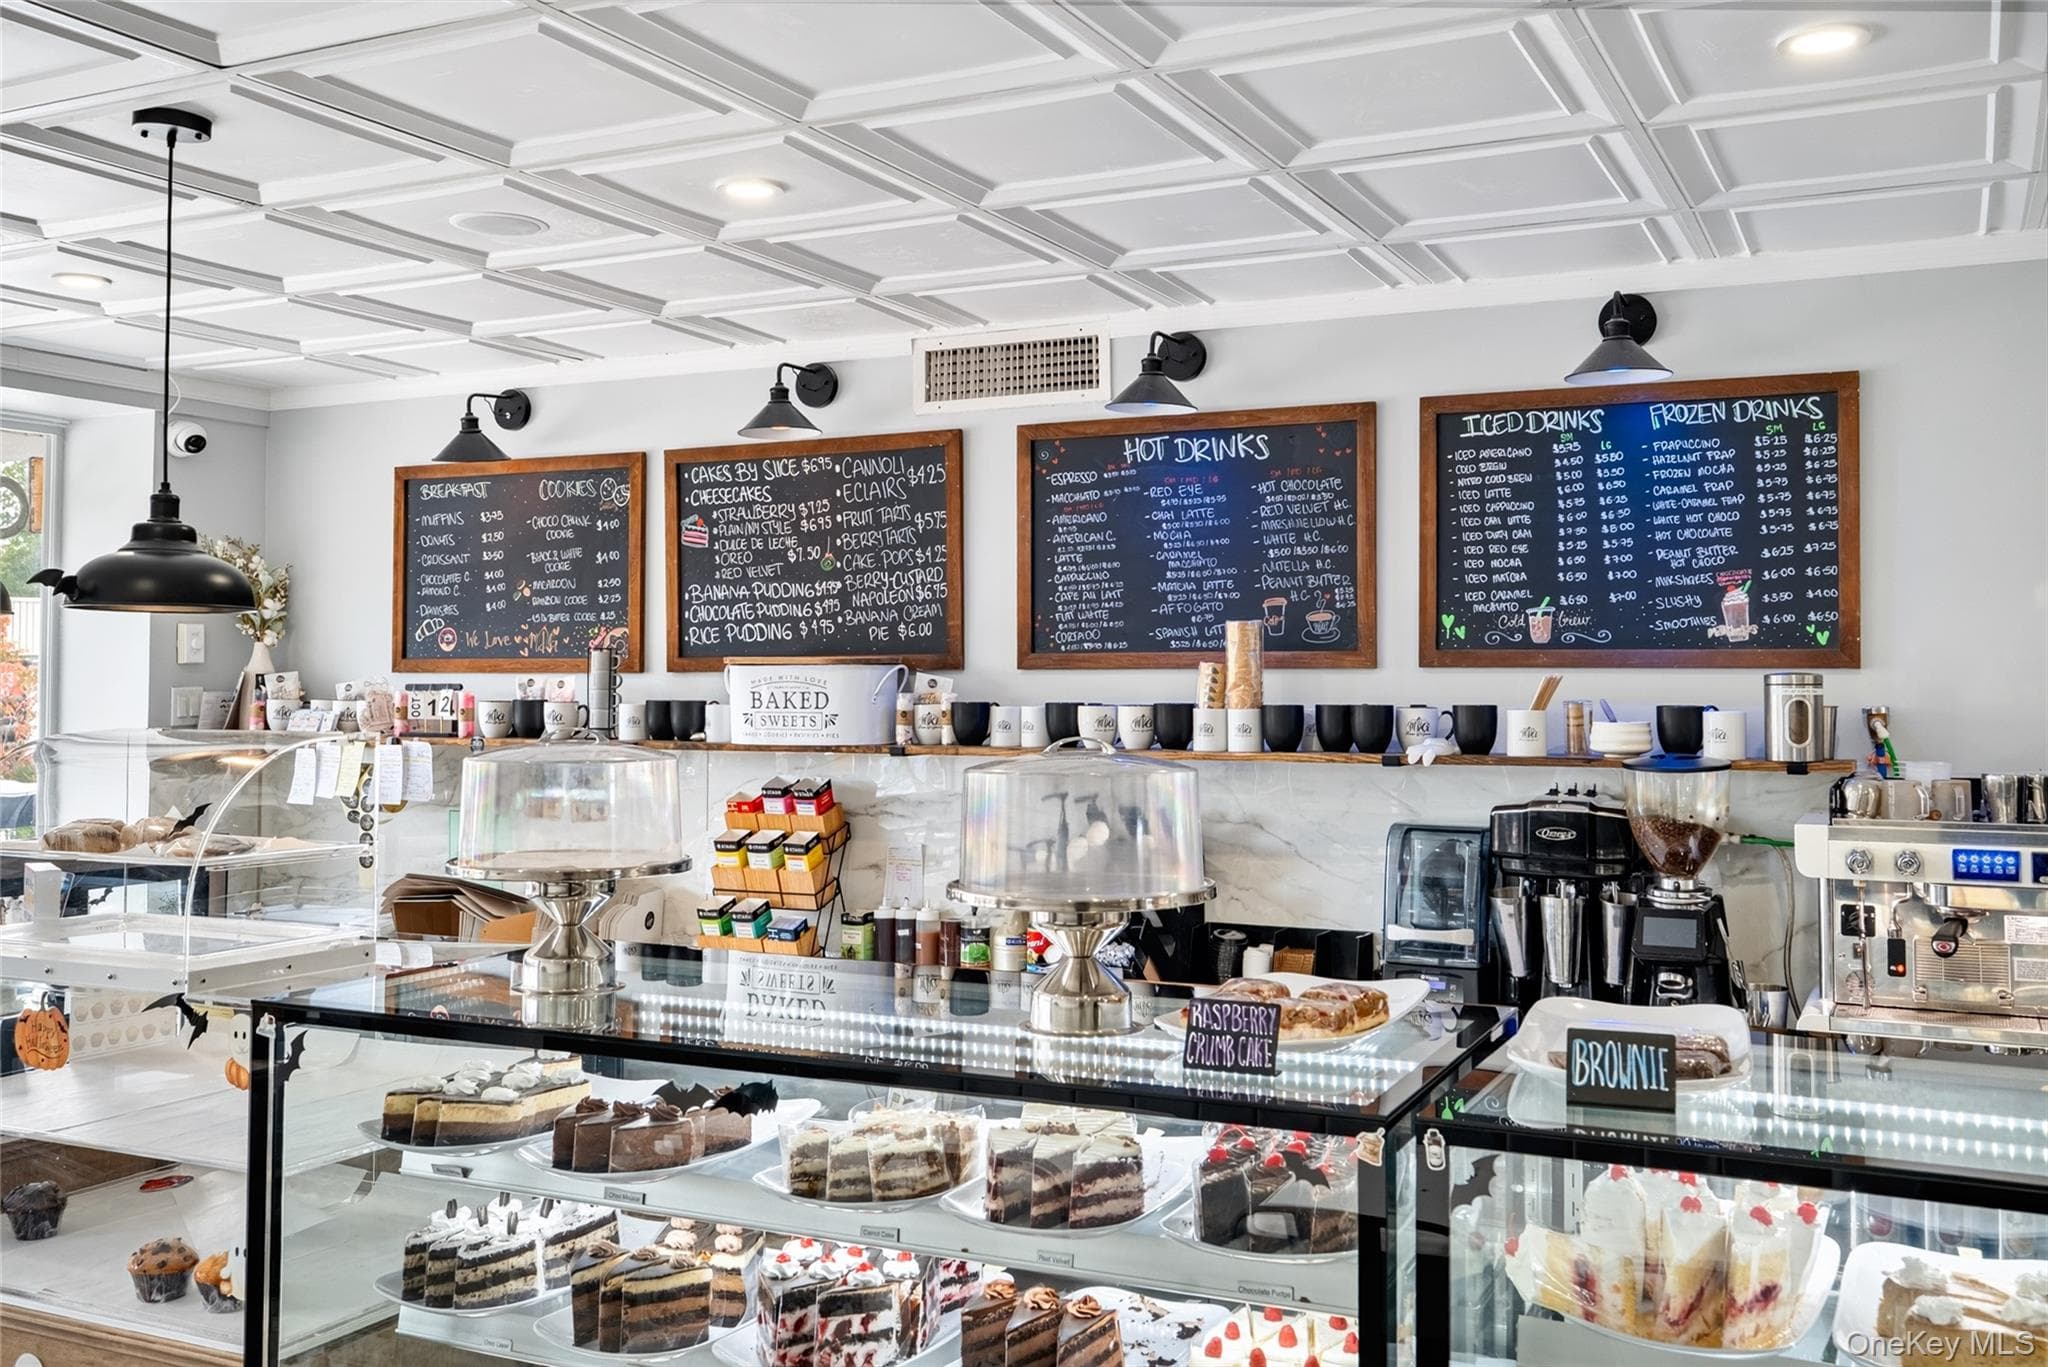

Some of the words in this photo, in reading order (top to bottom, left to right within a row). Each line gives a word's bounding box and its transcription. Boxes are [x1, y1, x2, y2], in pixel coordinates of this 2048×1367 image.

[1650, 401, 1727, 430] FROZEN
[1732, 396, 1824, 423] DRINKS
[1459, 411, 1523, 438] ICED
[1526, 409, 1604, 435] DRINKS
[1766, 424, 1784, 436] SM
[1812, 421, 1827, 431] LG
[1123, 436, 1168, 465] HOT
[1174, 434, 1271, 463] DRINKS
[1601, 440, 1612, 450] LG
[1653, 438, 1720, 452] FRAPUCCINO
[1455, 449, 1476, 461] ICED
[1652, 451, 1702, 466] HAZELNUT
[1706, 448, 1736, 461] FRAP
[691, 464, 733, 483] CAKES
[734, 462, 758, 482] BY
[762, 459, 800, 481] SLICE
[842, 456, 905, 479] CANNOLI
[1455, 464, 1476, 475] COLD
[1653, 468, 1691, 480] FROZEN
[1697, 463, 1735, 477] MOCHA
[1050, 471, 1098, 486] ESPRESSO
[1257, 480, 1276, 494] HOT
[1280, 477, 1343, 492] CHOCOLATE
[1484, 474, 1505, 485] COLD
[420, 482, 491, 500] BREAKFAST
[539, 479, 597, 500] COOKIES
[843, 476, 907, 503] ECLAIRS
[1150, 487, 1173, 498] RED
[1178, 484, 1203, 497] EYE
[1458, 490, 1480, 501] ICED
[1484, 487, 1512, 499] LATTE
[1704, 480, 1734, 493] FRAP
[690, 485, 772, 506] CHEESECAKES
[718, 503, 796, 523] STRAWBERRY
[1151, 511, 1175, 520] CHAI
[1181, 508, 1215, 520] LATTE
[1260, 503, 1283, 517] RED
[1286, 500, 1329, 515] VELVET
[1459, 503, 1481, 513] ICED
[422, 511, 465, 526] MUFFINS
[842, 508, 874, 528] FRUIT
[876, 504, 911, 524] TARTS
[1052, 511, 1107, 525] AMERICANO
[1460, 516, 1481, 527] ICED
[1653, 514, 1680, 525] WHITE
[1686, 512, 1704, 523] HOT
[1707, 510, 1740, 523] CHOCO
[761, 520, 792, 535] STYLE
[1655, 530, 1671, 541] HOT
[1676, 527, 1733, 541] CHOCOLATE
[841, 531, 883, 552] BERRY
[882, 526, 917, 545] TARTS
[1153, 530, 1192, 541] MOCHA
[1263, 532, 1296, 545] WHITE
[1462, 531, 1483, 542] ICED
[719, 538, 748, 552] DULCE
[751, 538, 764, 550] DE
[768, 536, 798, 550] LECHE
[1463, 545, 1484, 555] ICED
[1488, 544, 1508, 554] RED
[720, 551, 753, 566] OREO
[843, 553, 876, 572] CAKE
[881, 548, 914, 569] POPS
[1054, 553, 1083, 564] LATTE
[1656, 547, 1691, 561] PEANUT
[1695, 544, 1739, 559] BUTTER
[721, 566, 742, 579] RED
[746, 562, 784, 578] VELVET
[1262, 560, 1309, 574] NUTELLA
[1463, 559, 1485, 569] ICED
[1202, 579, 1234, 591] LATTE
[1261, 574, 1303, 590] PEANUT
[1306, 573, 1351, 588] BUTTER
[1465, 573, 1488, 584] ICED
[688, 584, 751, 604] BANANA
[751, 582, 815, 600] PUDDING
[852, 586, 915, 607] NAPOLEON
[1464, 591, 1486, 602] ICED
[690, 602, 755, 623] CHOCOLATE
[755, 602, 813, 618] PUDDING
[843, 608, 899, 626] BANANA
[903, 603, 943, 622] CREAM
[1077, 608, 1110, 620] WHITE
[1159, 602, 1223, 615] AFFOGATO
[1498, 614, 1526, 629] Cold
[485, 630, 515, 649] Love
[689, 626, 721, 646] RICE
[724, 623, 793, 643] PUDDING
[868, 626, 890, 641] PIE
[1155, 626, 1198, 641] SPANISH
[411, 697, 421, 718] OCT
[750, 691, 830, 711] BAKED
[760, 715, 817, 729] SWEETS
[1191, 1002, 1277, 1036] RASPBERRY
[1186, 1031, 1236, 1068] CRUMB
[1238, 1036, 1273, 1068] CAKE
[1571, 1038, 1670, 1092] BROWNIE
